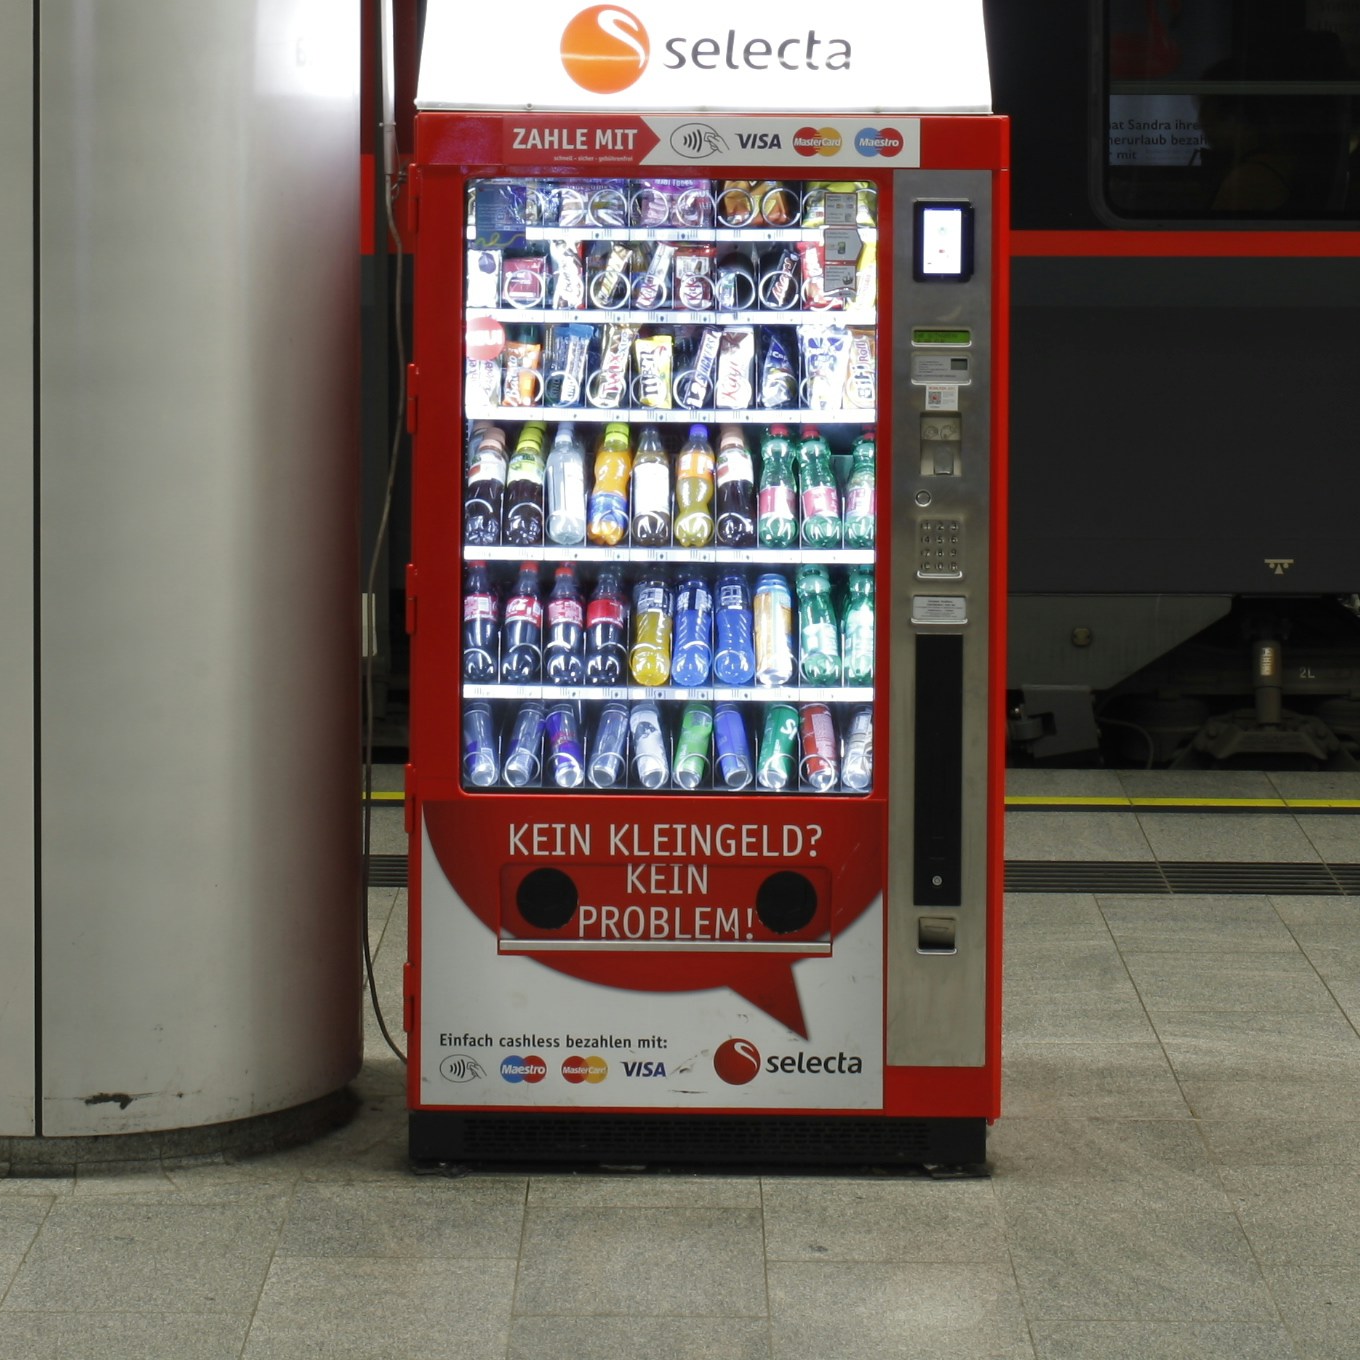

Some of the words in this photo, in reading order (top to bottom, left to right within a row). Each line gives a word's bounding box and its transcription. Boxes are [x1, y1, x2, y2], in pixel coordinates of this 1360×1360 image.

[663, 29, 852, 71] selecta
[1127, 119, 1171, 130] Sandra
[512, 128, 588, 149] ZAHLE
[595, 129, 638, 150] MIT
[735, 133, 782, 150] VISA
[793, 136, 841, 148] MasterCard
[858, 137, 900, 149] Maestro
[1116, 149, 1137, 160] mit
[1299, 666, 1316, 679] 2L
[508, 823, 591, 856] KEIN
[609, 823, 823, 857] KLEINGELD?
[626, 863, 708, 894] KEIN
[578, 905, 754, 940] PROBLEM!
[440, 1033, 493, 1048] Einfach
[499, 1034, 560, 1048] cashless
[566, 1034, 632, 1049] bezahlen
[638, 1035, 668, 1049] mit:
[501, 1063, 546, 1076] Maestro
[562, 1065, 608, 1075] MasterCard
[620, 1061, 667, 1078] VISA
[765, 1051, 863, 1074] selecta
